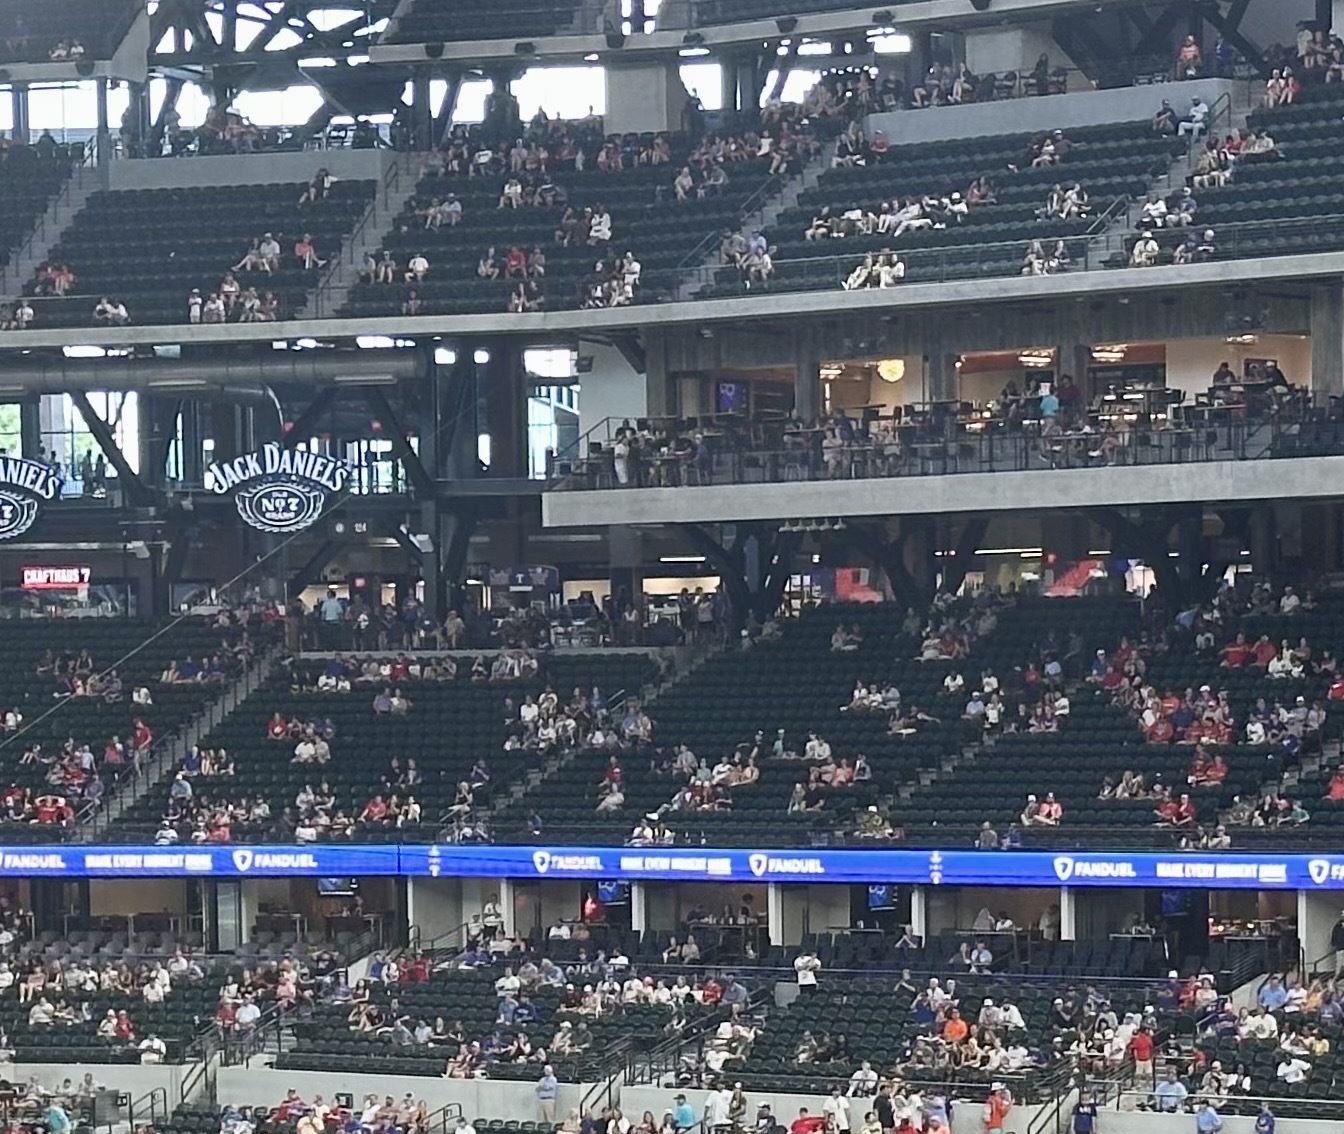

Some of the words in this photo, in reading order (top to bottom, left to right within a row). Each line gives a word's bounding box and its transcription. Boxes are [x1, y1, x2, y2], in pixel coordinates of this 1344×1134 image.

[209, 452, 263, 494] JACK
[263, 444, 349, 492] DANIEL'S
[4, 855, 66, 869] FANDUEL
[254, 853, 318, 867] FANDUEL
[768, 859, 825, 873] FANDUEL
[1074, 862, 1136, 877] FANDUEL
